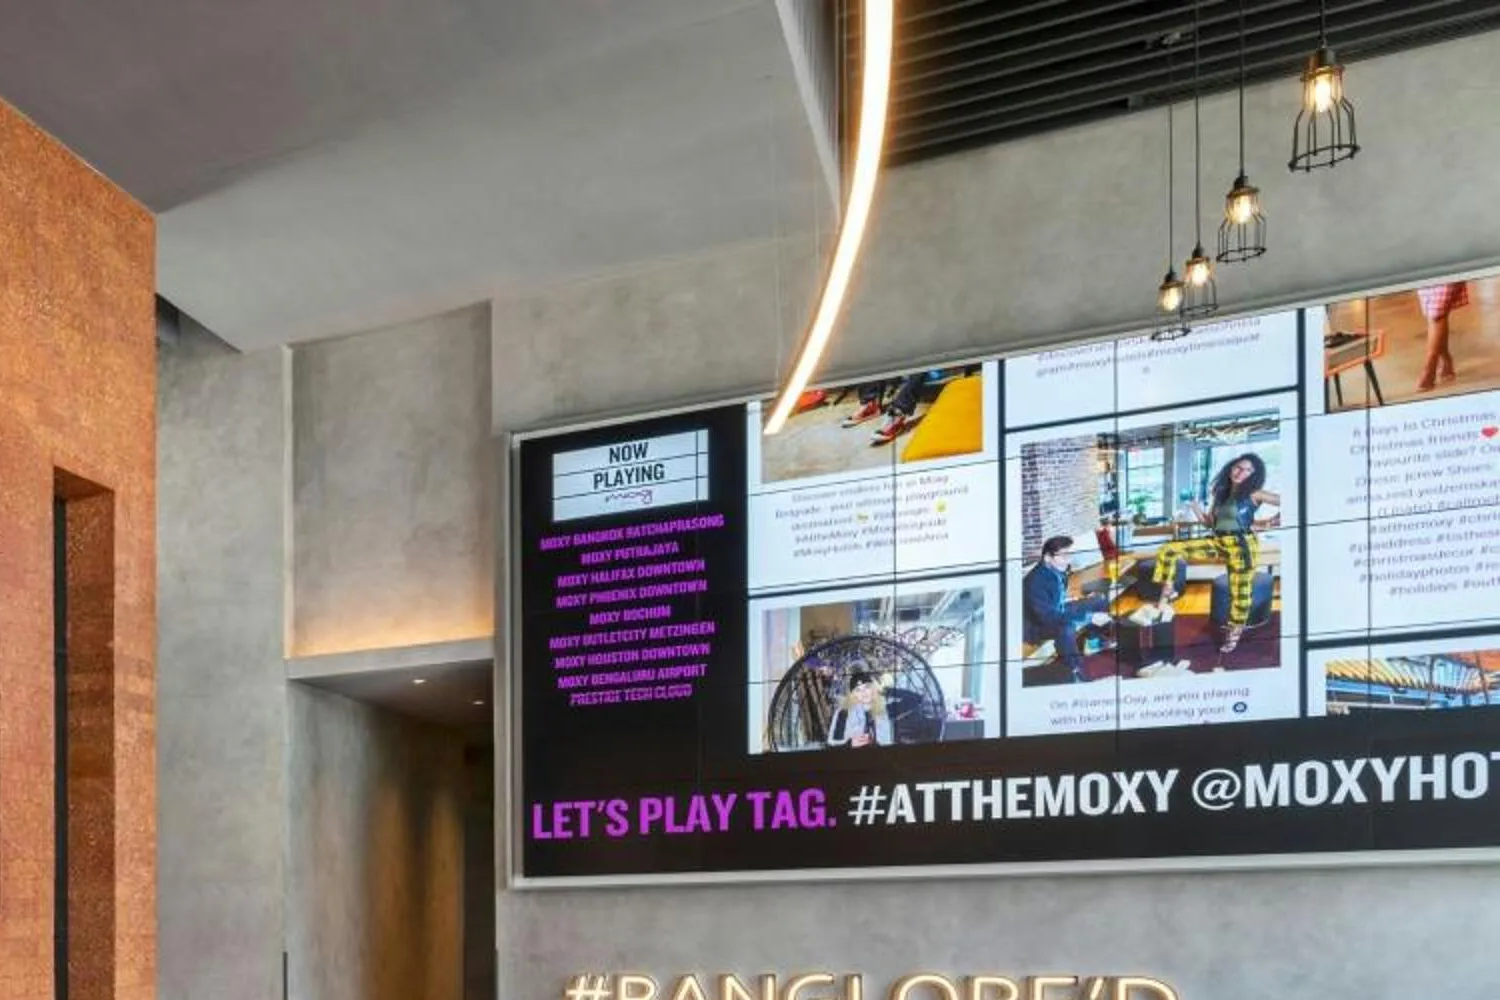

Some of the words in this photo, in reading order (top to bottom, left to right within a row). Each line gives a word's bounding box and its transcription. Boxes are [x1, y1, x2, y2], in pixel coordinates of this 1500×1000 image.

[608, 441, 650, 464] NOW
[593, 463, 665, 490] PLAYING
[540, 535, 572, 551] MOXY
[580, 550, 612, 566] MOXY
[557, 573, 589, 588] MOXY
[590, 566, 636, 584] HALIFAX
[637, 559, 706, 578] DOWNTOWN
[555, 593, 588, 609] MOXY
[639, 579, 708, 598] DOWNTOWN
[589, 610, 621, 625] MOXY
[549, 634, 581, 650] MOXY
[649, 620, 716, 640] METZINGEN
[555, 654, 587, 669] MOXY
[587, 648, 640, 666] HOUSTON
[641, 642, 711, 661] DOWNTOWN
[557, 674, 589, 689] MOXY
[657, 663, 708, 680] AIRPORT
[569, 689, 622, 706] PRESTIGE
[624, 687, 653, 702] TECH
[654, 683, 693, 700] CLOUD
[532, 798, 630, 840] LET'S
[639, 791, 739, 836] PLAY
[745, 787, 837, 830] TAG.
[847, 769, 1180, 826] #ATTHEMOXY
